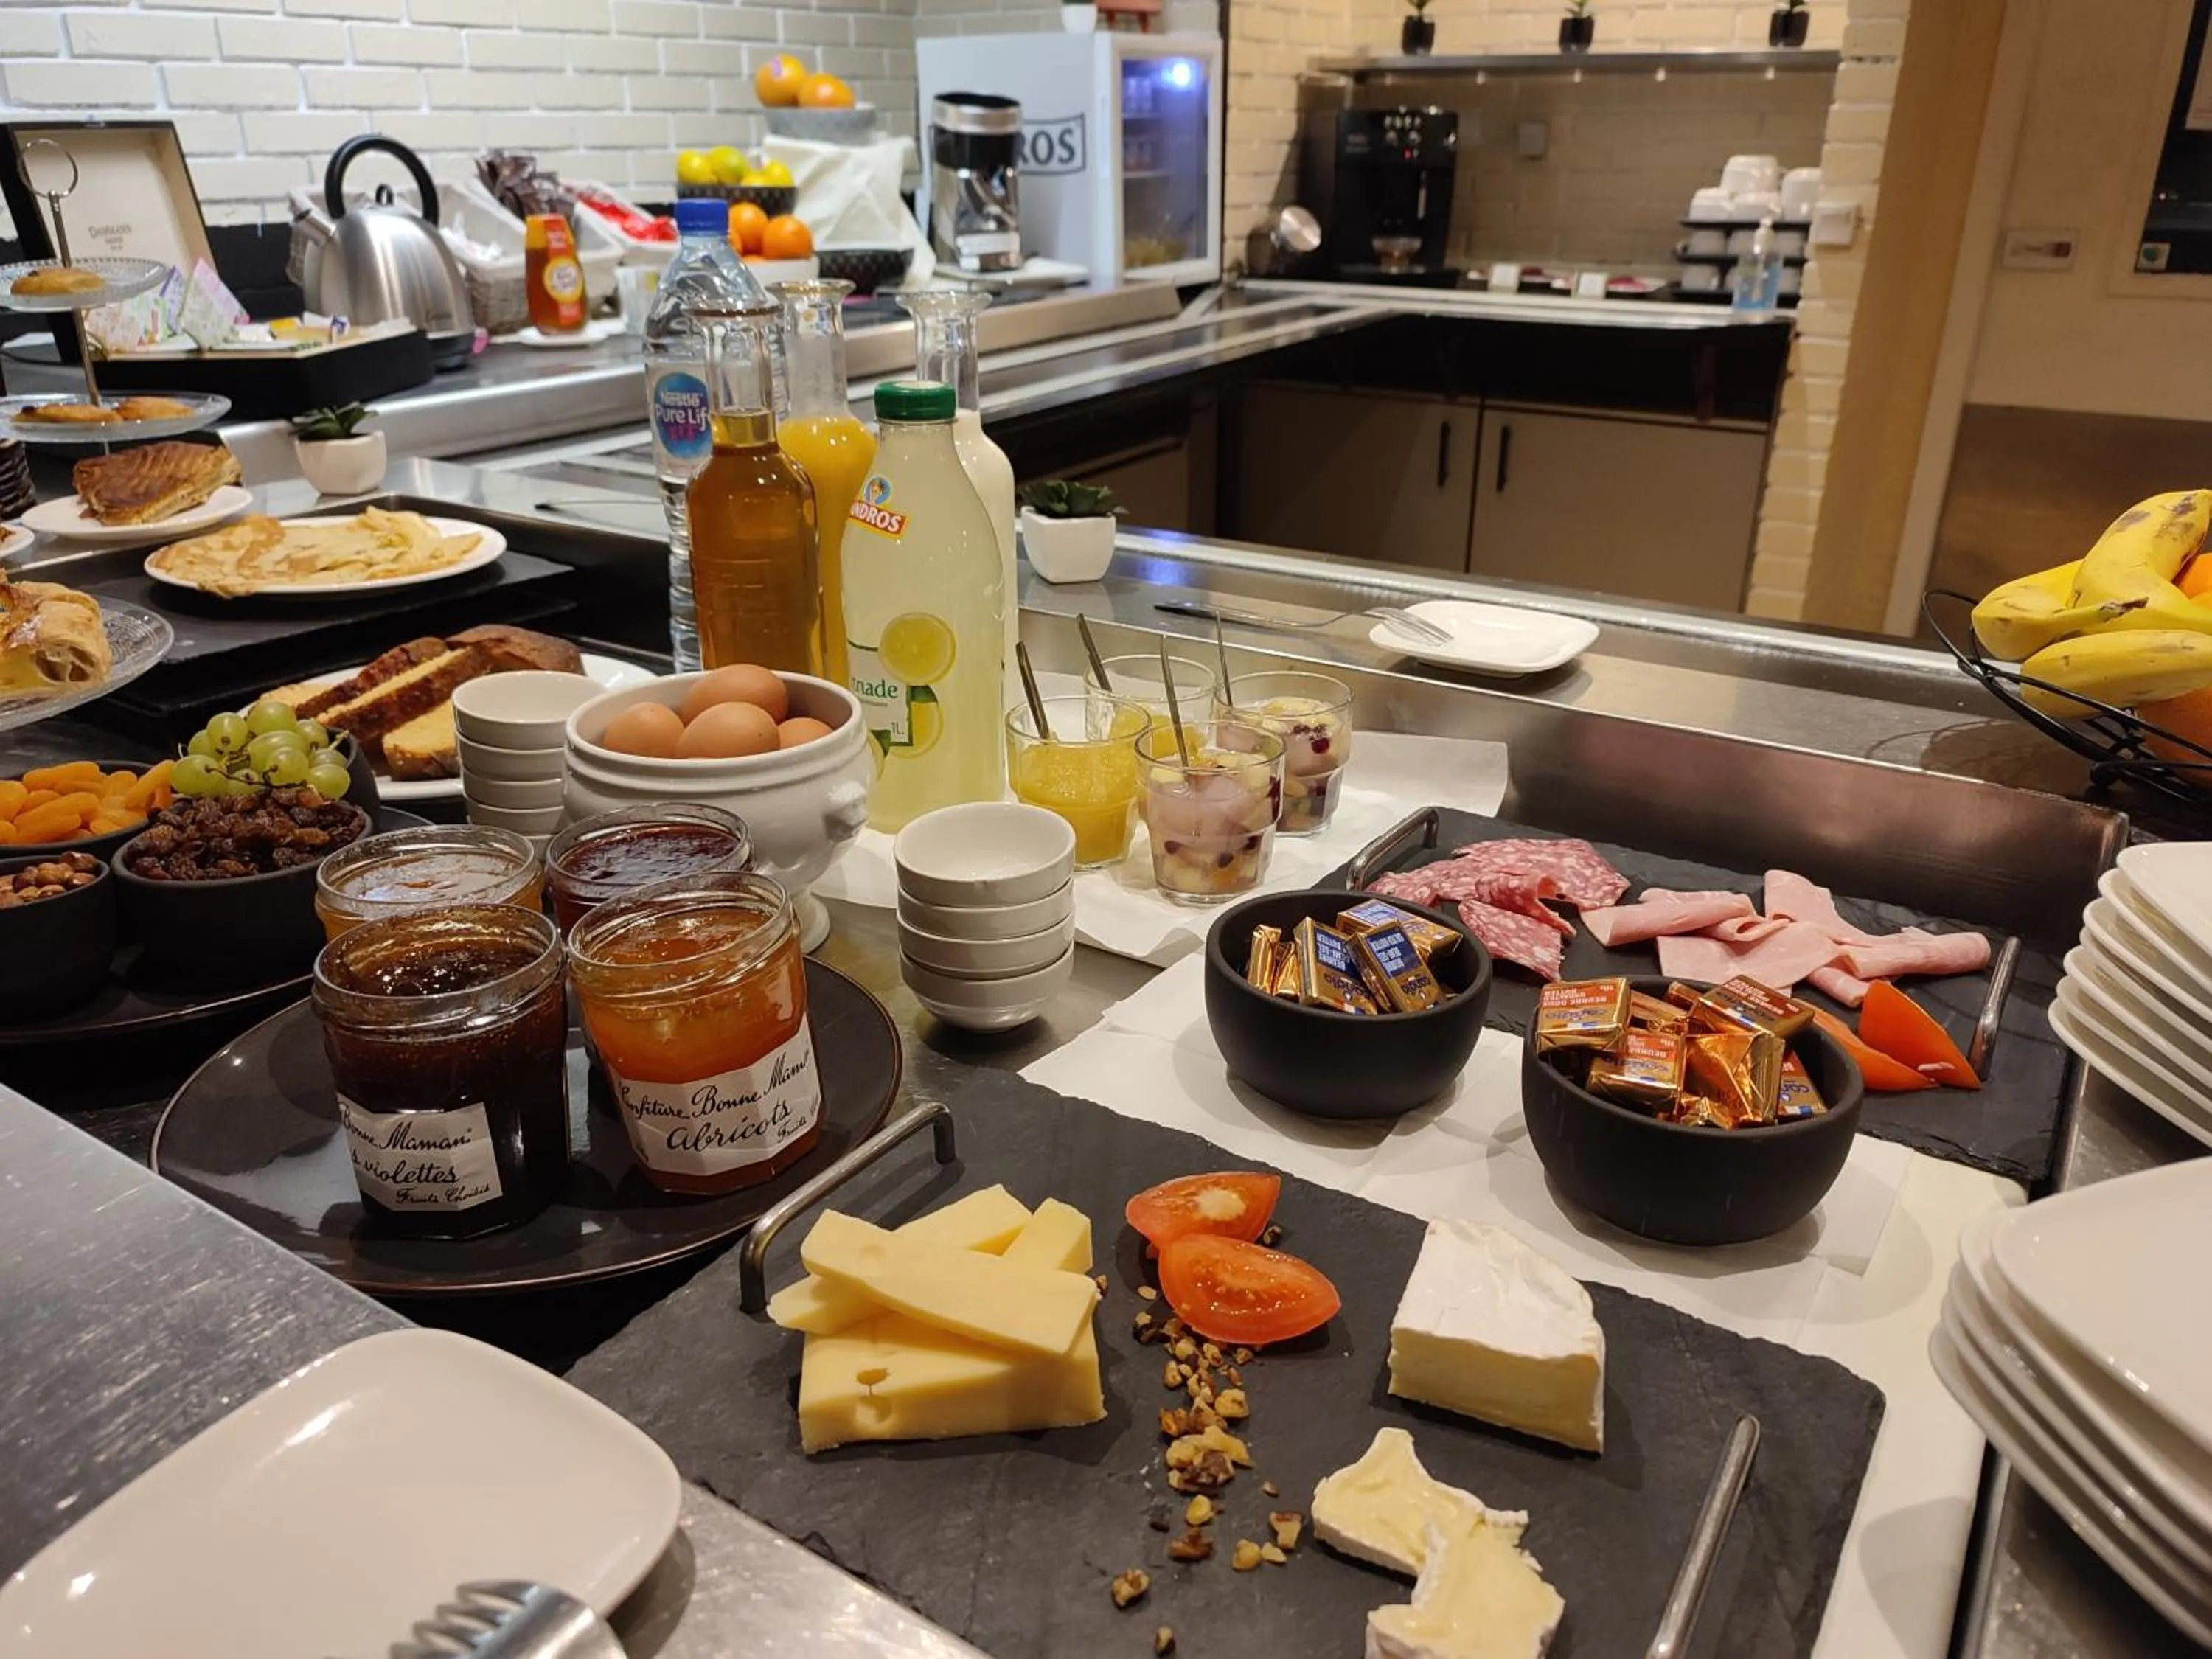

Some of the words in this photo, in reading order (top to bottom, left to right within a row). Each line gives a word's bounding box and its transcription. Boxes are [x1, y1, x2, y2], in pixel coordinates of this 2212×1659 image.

[1015, 128, 1075, 165] ROS
[655, 403, 686, 425] Pure
[686, 406, 709, 431] Lif
[850, 501, 902, 532] NDROS
[691, 1085, 762, 1118] Bonne
[667, 1099, 793, 1152] Abricots
[363, 1160, 460, 1184] violettes
[395, 1186, 439, 1204] Fruits
